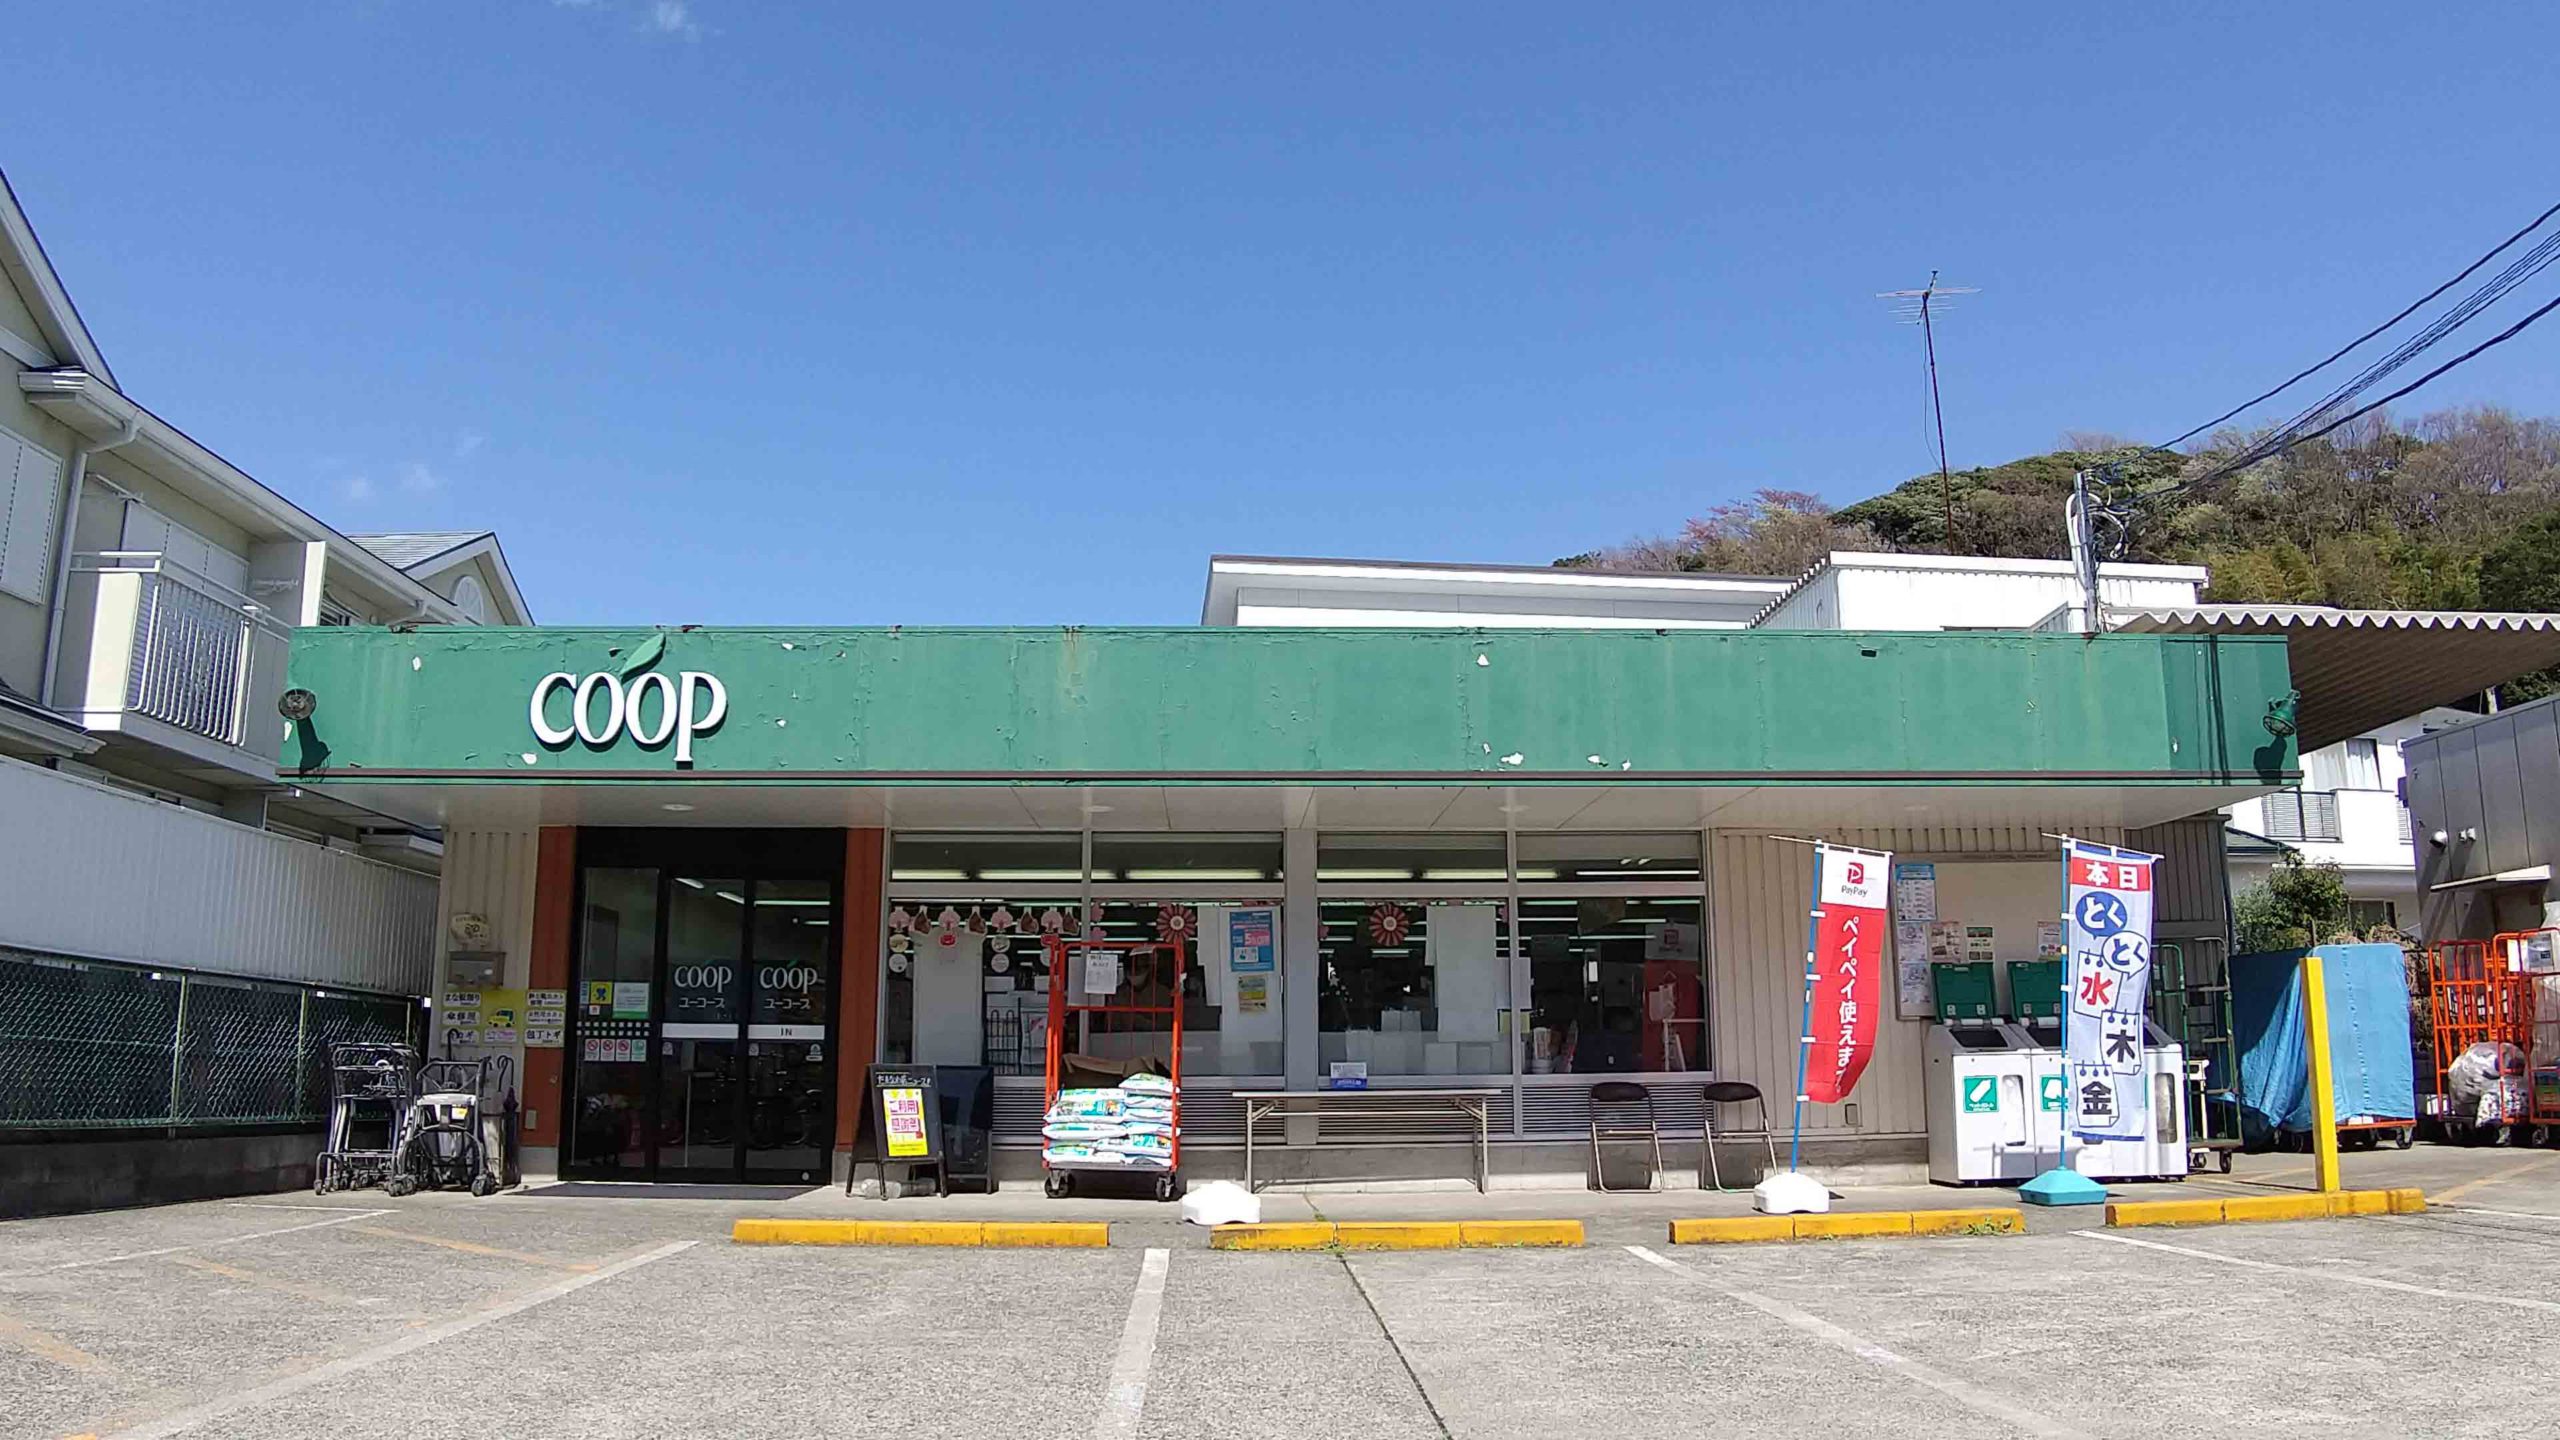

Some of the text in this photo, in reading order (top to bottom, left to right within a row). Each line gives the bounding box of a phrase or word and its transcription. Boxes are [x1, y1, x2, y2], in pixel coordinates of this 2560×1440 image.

[2085, 861, 2139, 890] 本日
[1841, 884, 1868, 898] PayPay
[2082, 897, 2126, 928] とく
[2110, 937, 2146, 964] とく
[2080, 975, 2112, 1007] 水
[781, 1027, 793, 1036] IN
[2105, 1029, 2136, 1063] 木
[2081, 1081, 2113, 1115] 金
